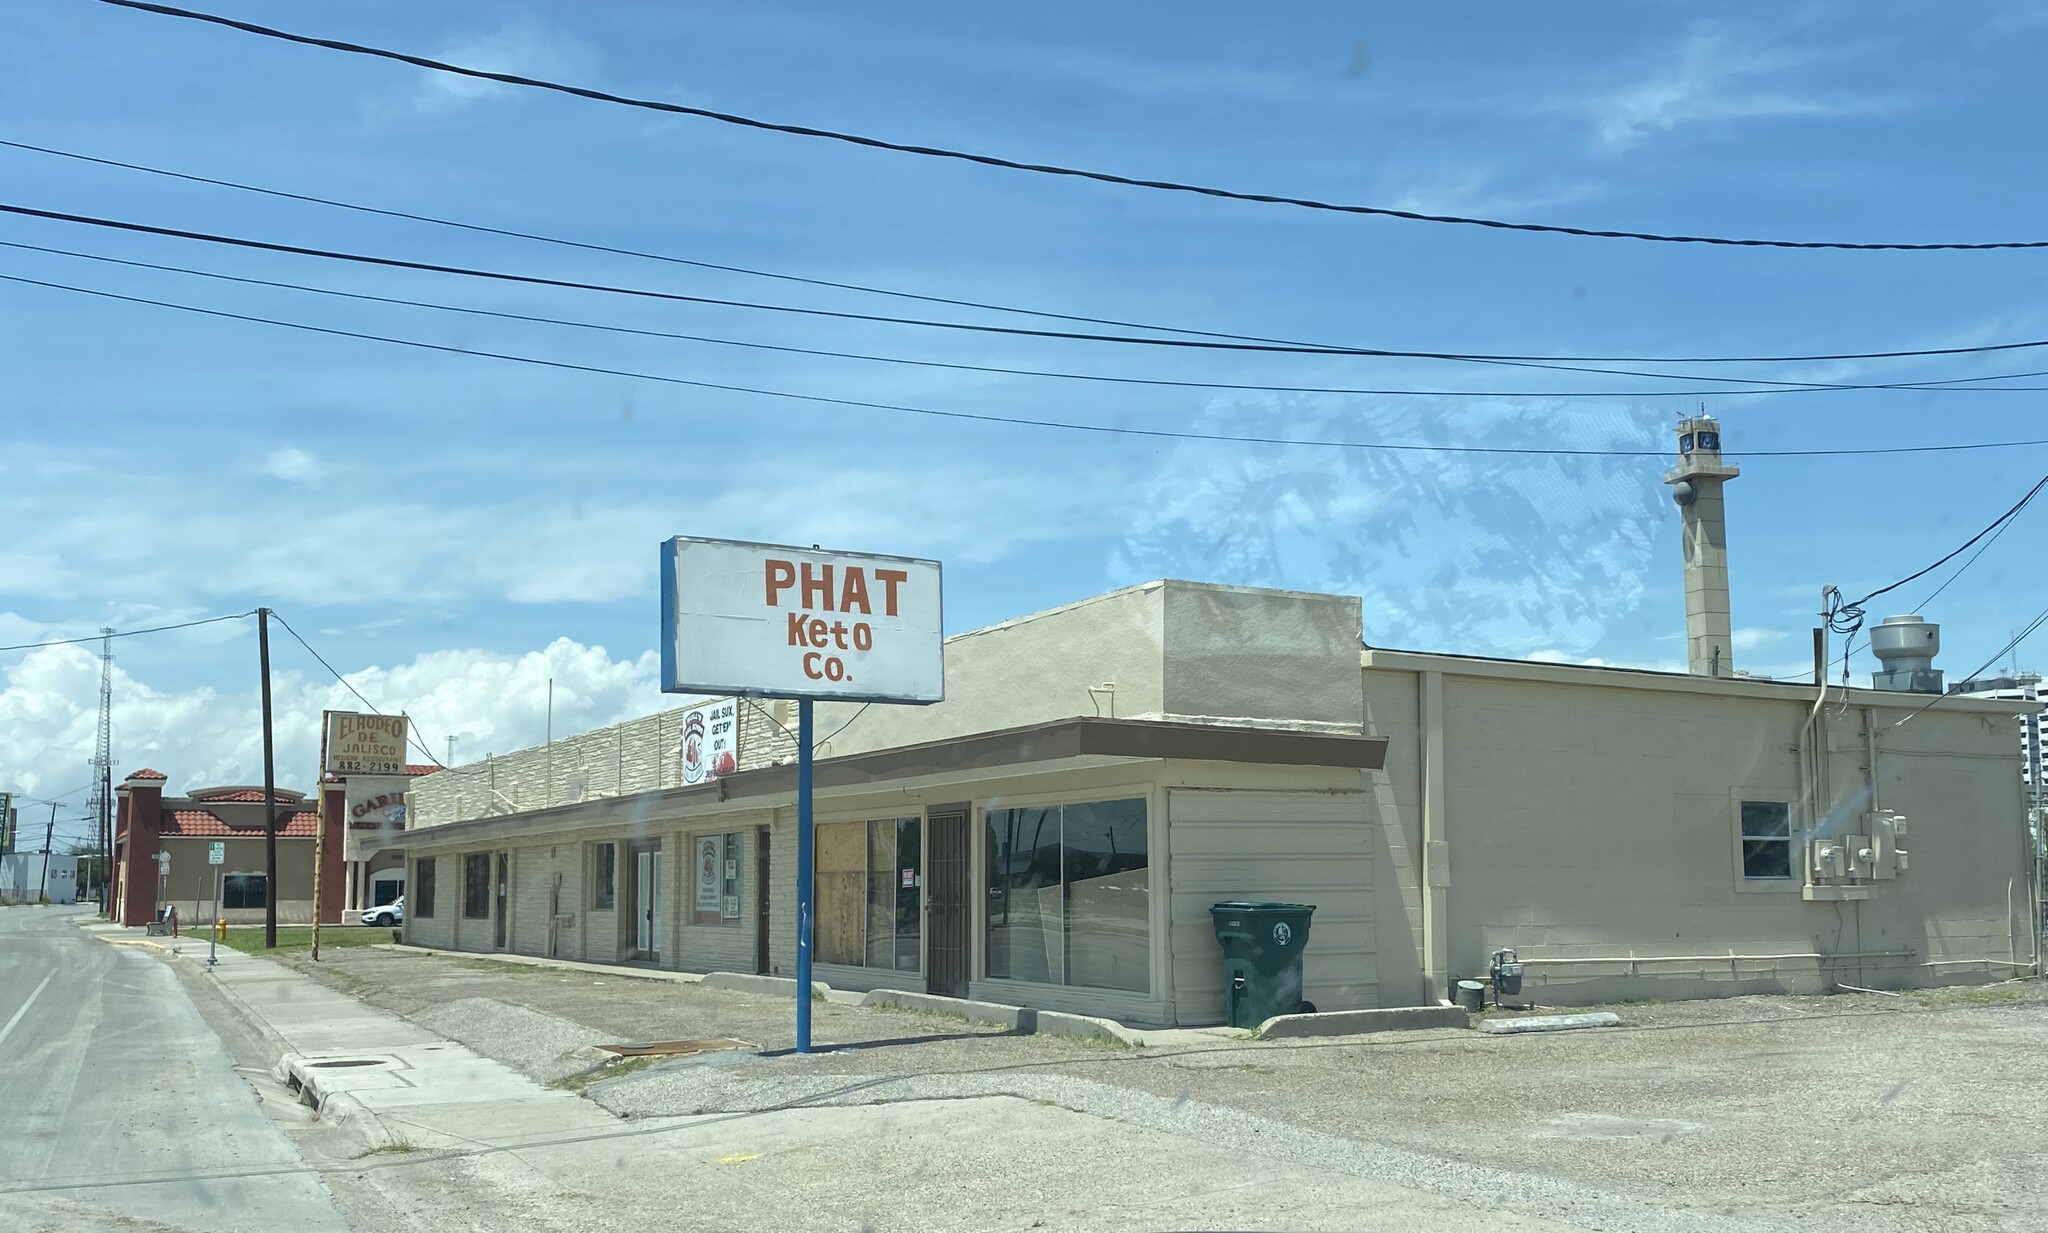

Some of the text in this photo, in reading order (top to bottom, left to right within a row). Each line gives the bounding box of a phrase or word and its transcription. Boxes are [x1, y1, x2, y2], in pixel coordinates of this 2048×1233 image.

[765, 558, 908, 617] PHAT
[787, 612, 873, 651] Keto
[802, 651, 853, 682] Co.
[339, 716, 403, 740] EL RODEO
[358, 732, 379, 743] DE
[343, 744, 396, 756] JALISCO
